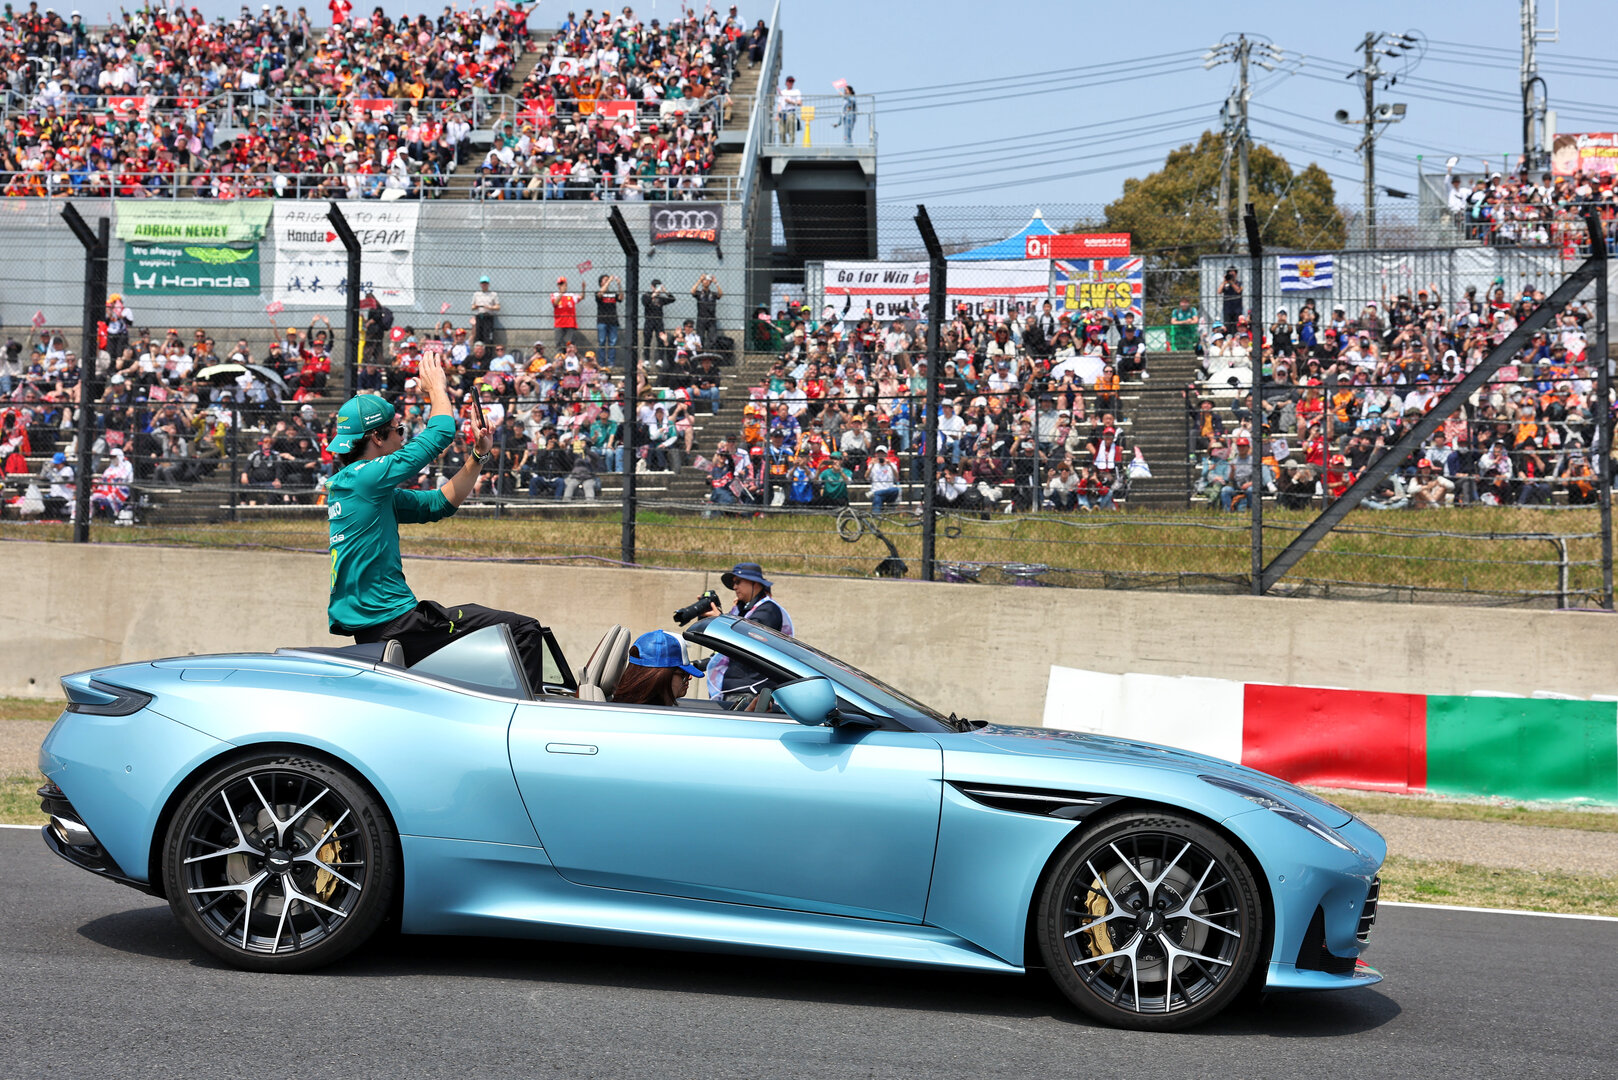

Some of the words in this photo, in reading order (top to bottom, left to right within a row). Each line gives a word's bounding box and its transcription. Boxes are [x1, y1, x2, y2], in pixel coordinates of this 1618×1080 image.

[356, 212, 373, 222] TO
[378, 213, 404, 222] ALL
[134, 224, 181, 237] ADRIAN
[185, 224, 229, 237] NEWEY
[287, 229, 324, 242] Honda
[352, 229, 406, 245] TEAM
[132, 246, 148, 256] We
[150, 247, 183, 257] always
[1027, 239, 1048, 256] Q1
[162, 275, 250, 287] Honda
[838, 269, 854, 283] Go
[859, 270, 879, 283] for
[883, 270, 909, 283] Win
